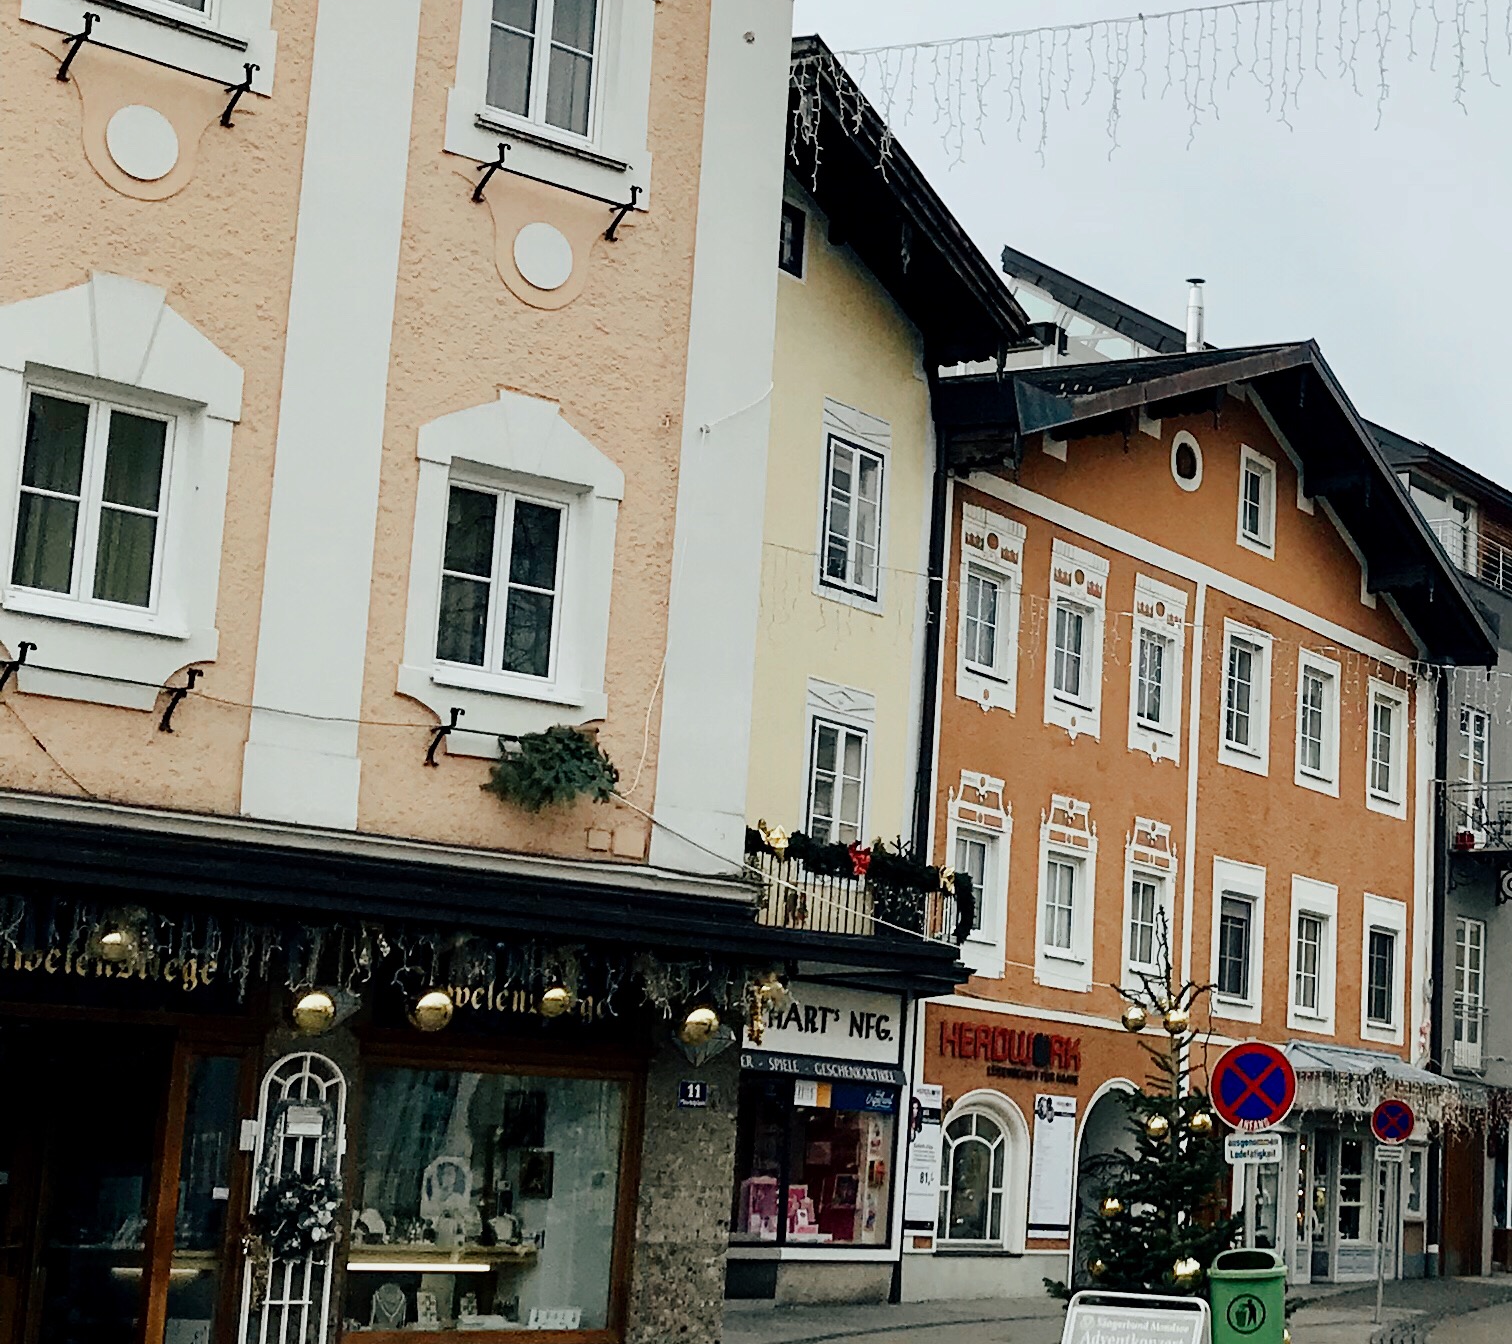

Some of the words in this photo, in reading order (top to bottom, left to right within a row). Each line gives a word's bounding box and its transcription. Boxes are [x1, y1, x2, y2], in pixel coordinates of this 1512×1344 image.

[848, 1010, 893, 1042] NFG.
[768, 1057, 800, 1073] SPIELE
[814, 1062, 897, 1084] GESCHENKARTIKEL
[687, 1083, 700, 1098] 11
